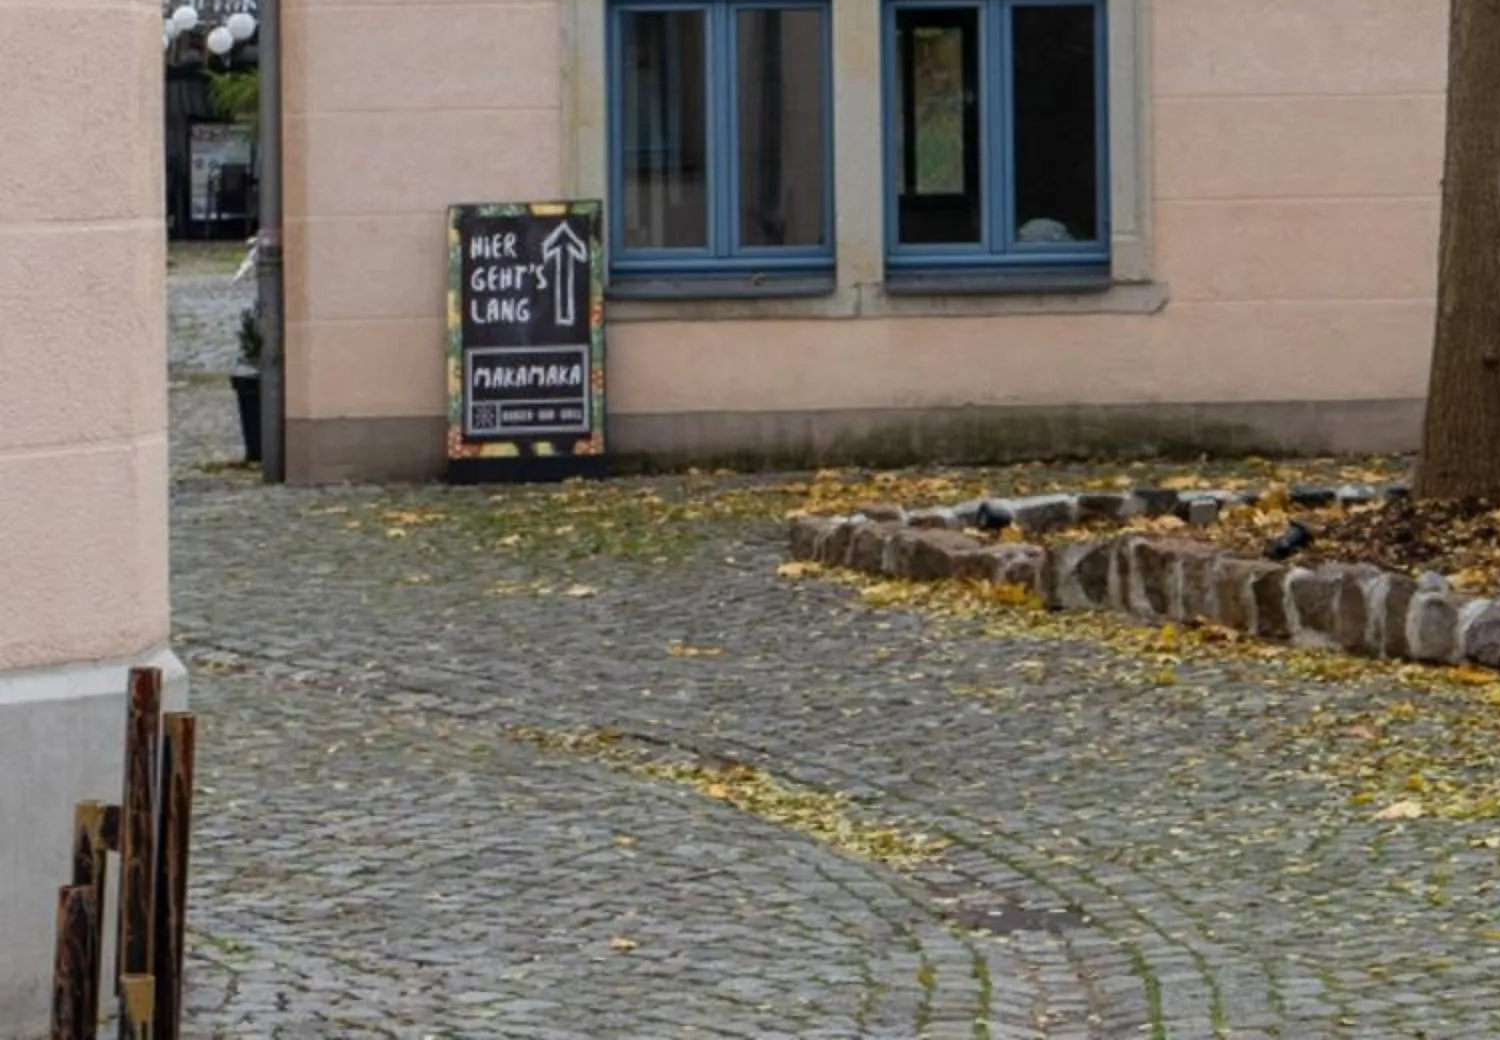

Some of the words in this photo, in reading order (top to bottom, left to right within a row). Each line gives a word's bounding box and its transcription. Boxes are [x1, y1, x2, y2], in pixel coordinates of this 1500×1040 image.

[471, 264, 548, 292] GEHT'S
[471, 298, 530, 324] LANG
[474, 364, 582, 388] MAKAMAKA
